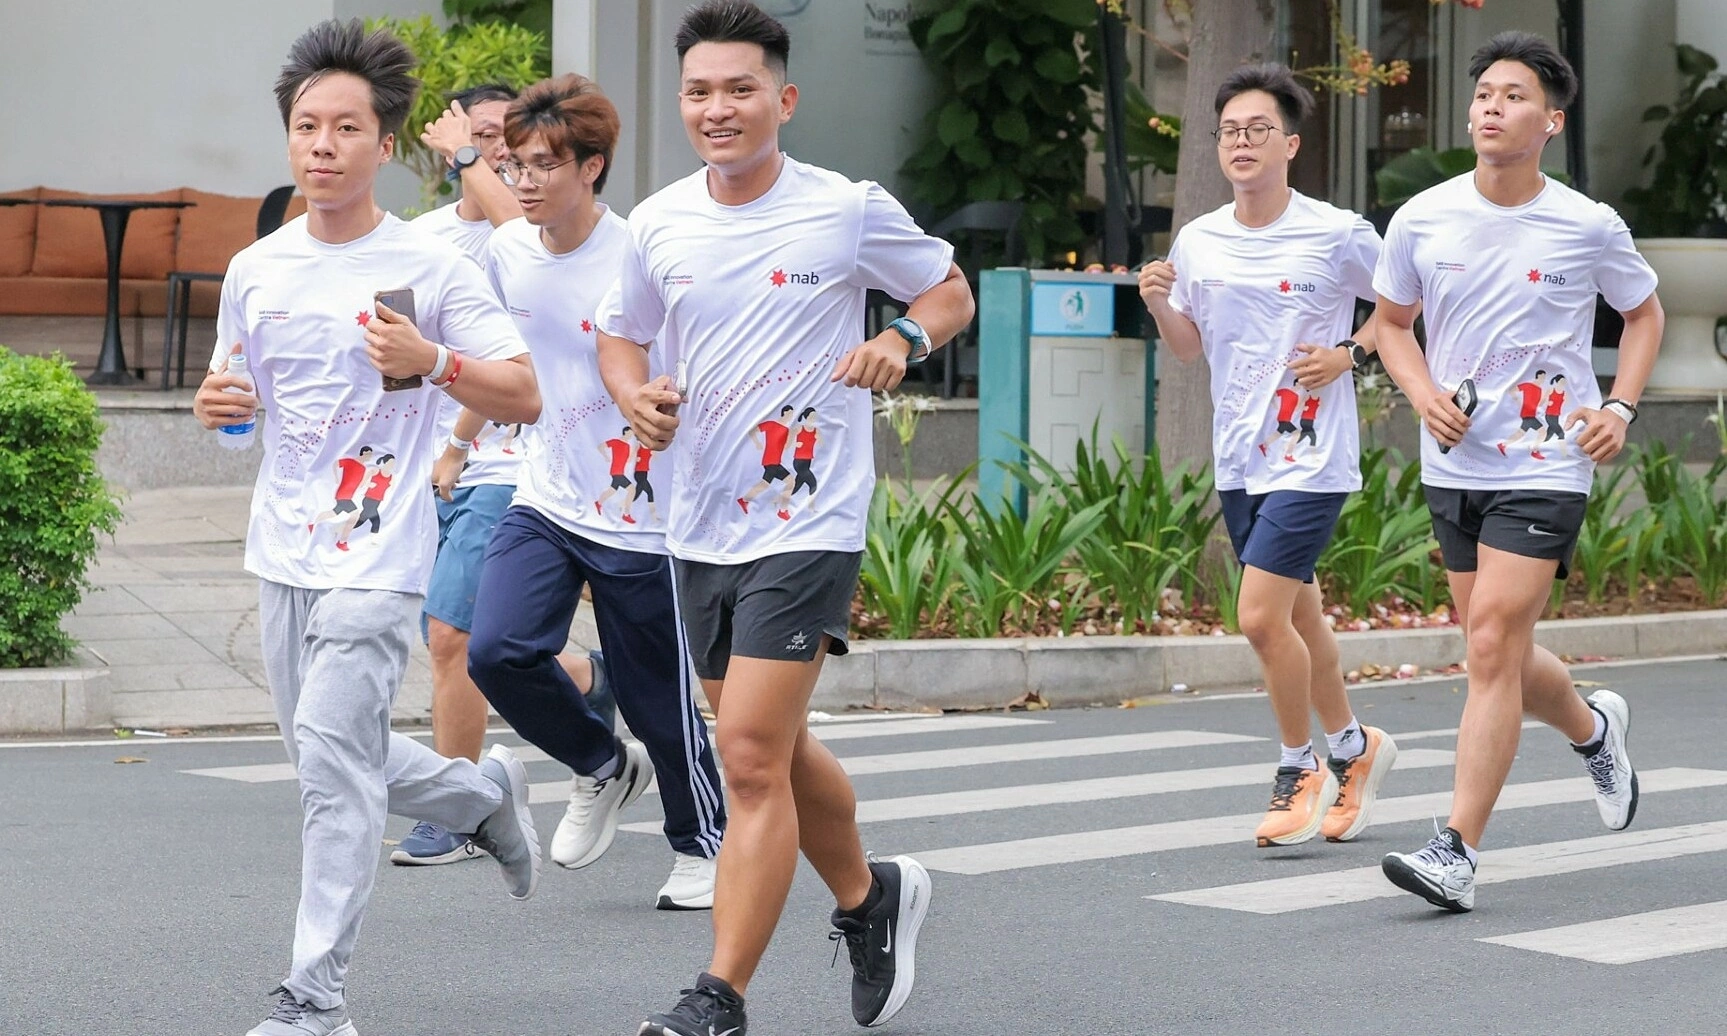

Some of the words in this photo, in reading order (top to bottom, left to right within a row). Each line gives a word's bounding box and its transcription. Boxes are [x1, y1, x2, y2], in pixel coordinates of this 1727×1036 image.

[791, 272, 819, 285] nab
[1543, 274, 1566, 285] nab
[1293, 282, 1316, 292] nab
